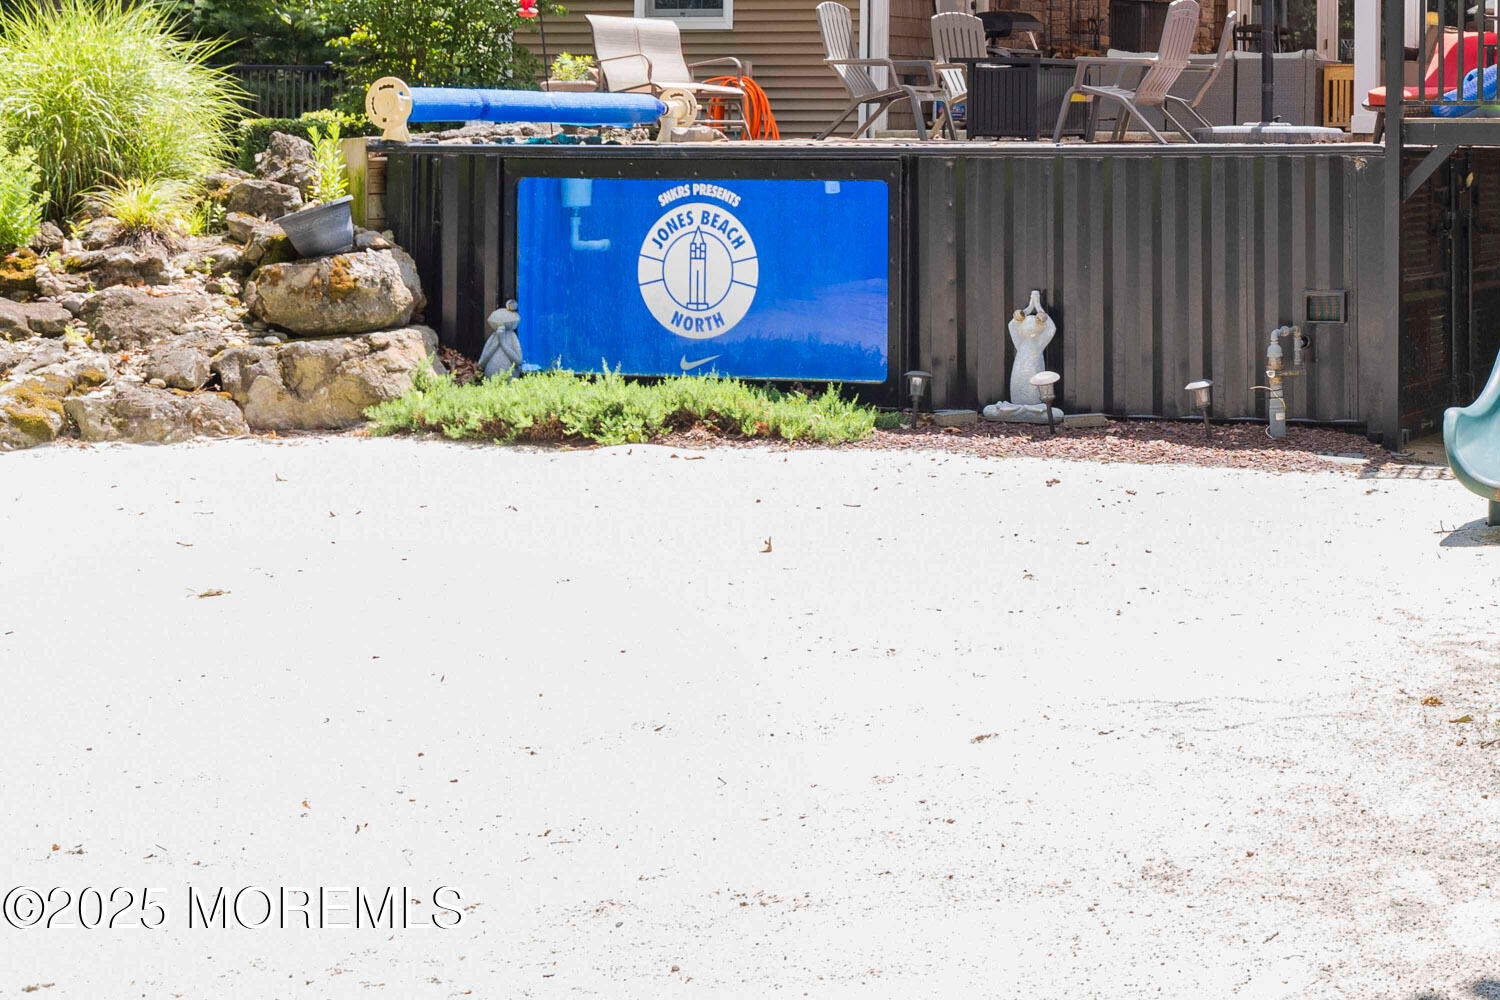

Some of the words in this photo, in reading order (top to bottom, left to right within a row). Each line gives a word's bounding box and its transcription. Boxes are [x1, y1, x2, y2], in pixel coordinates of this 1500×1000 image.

[658, 184, 691, 207] SNKRS
[692, 183, 742, 208] PRESENTS
[652, 210, 694, 250] JONES
[700, 210, 746, 250] BEACH
[671, 310, 725, 332] NORTH
